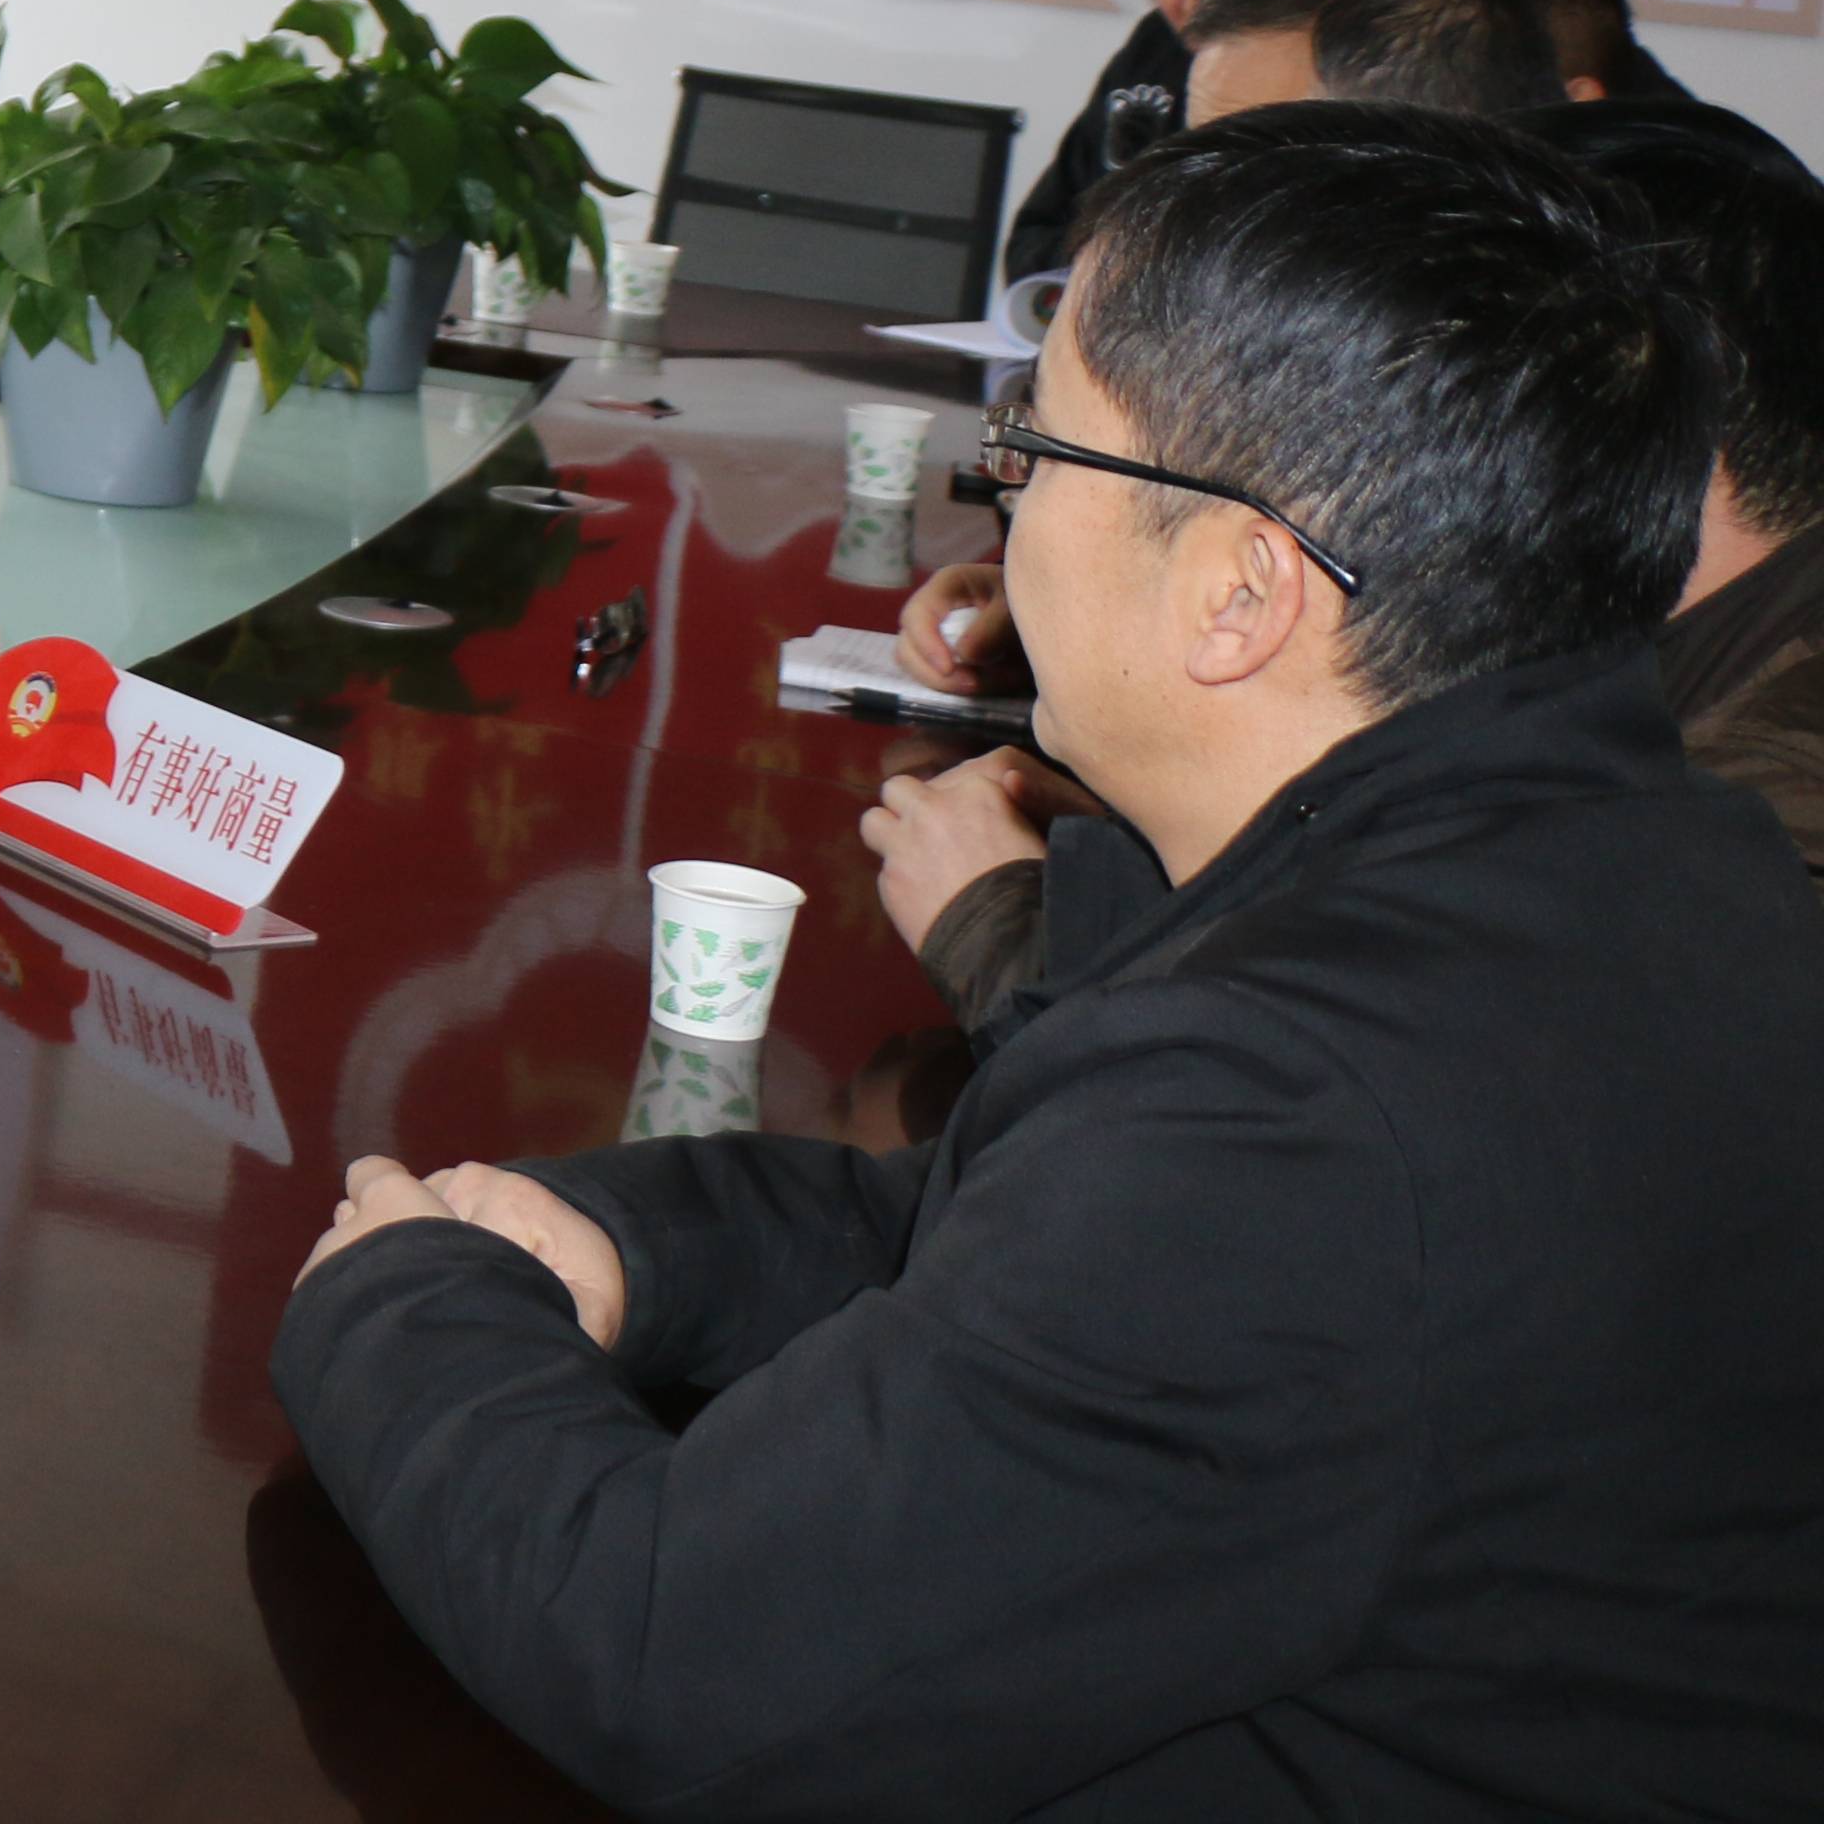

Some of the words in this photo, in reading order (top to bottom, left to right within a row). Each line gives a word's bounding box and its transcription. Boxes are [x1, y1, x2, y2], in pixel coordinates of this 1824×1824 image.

[116, 720, 298, 865] 有事好商量
